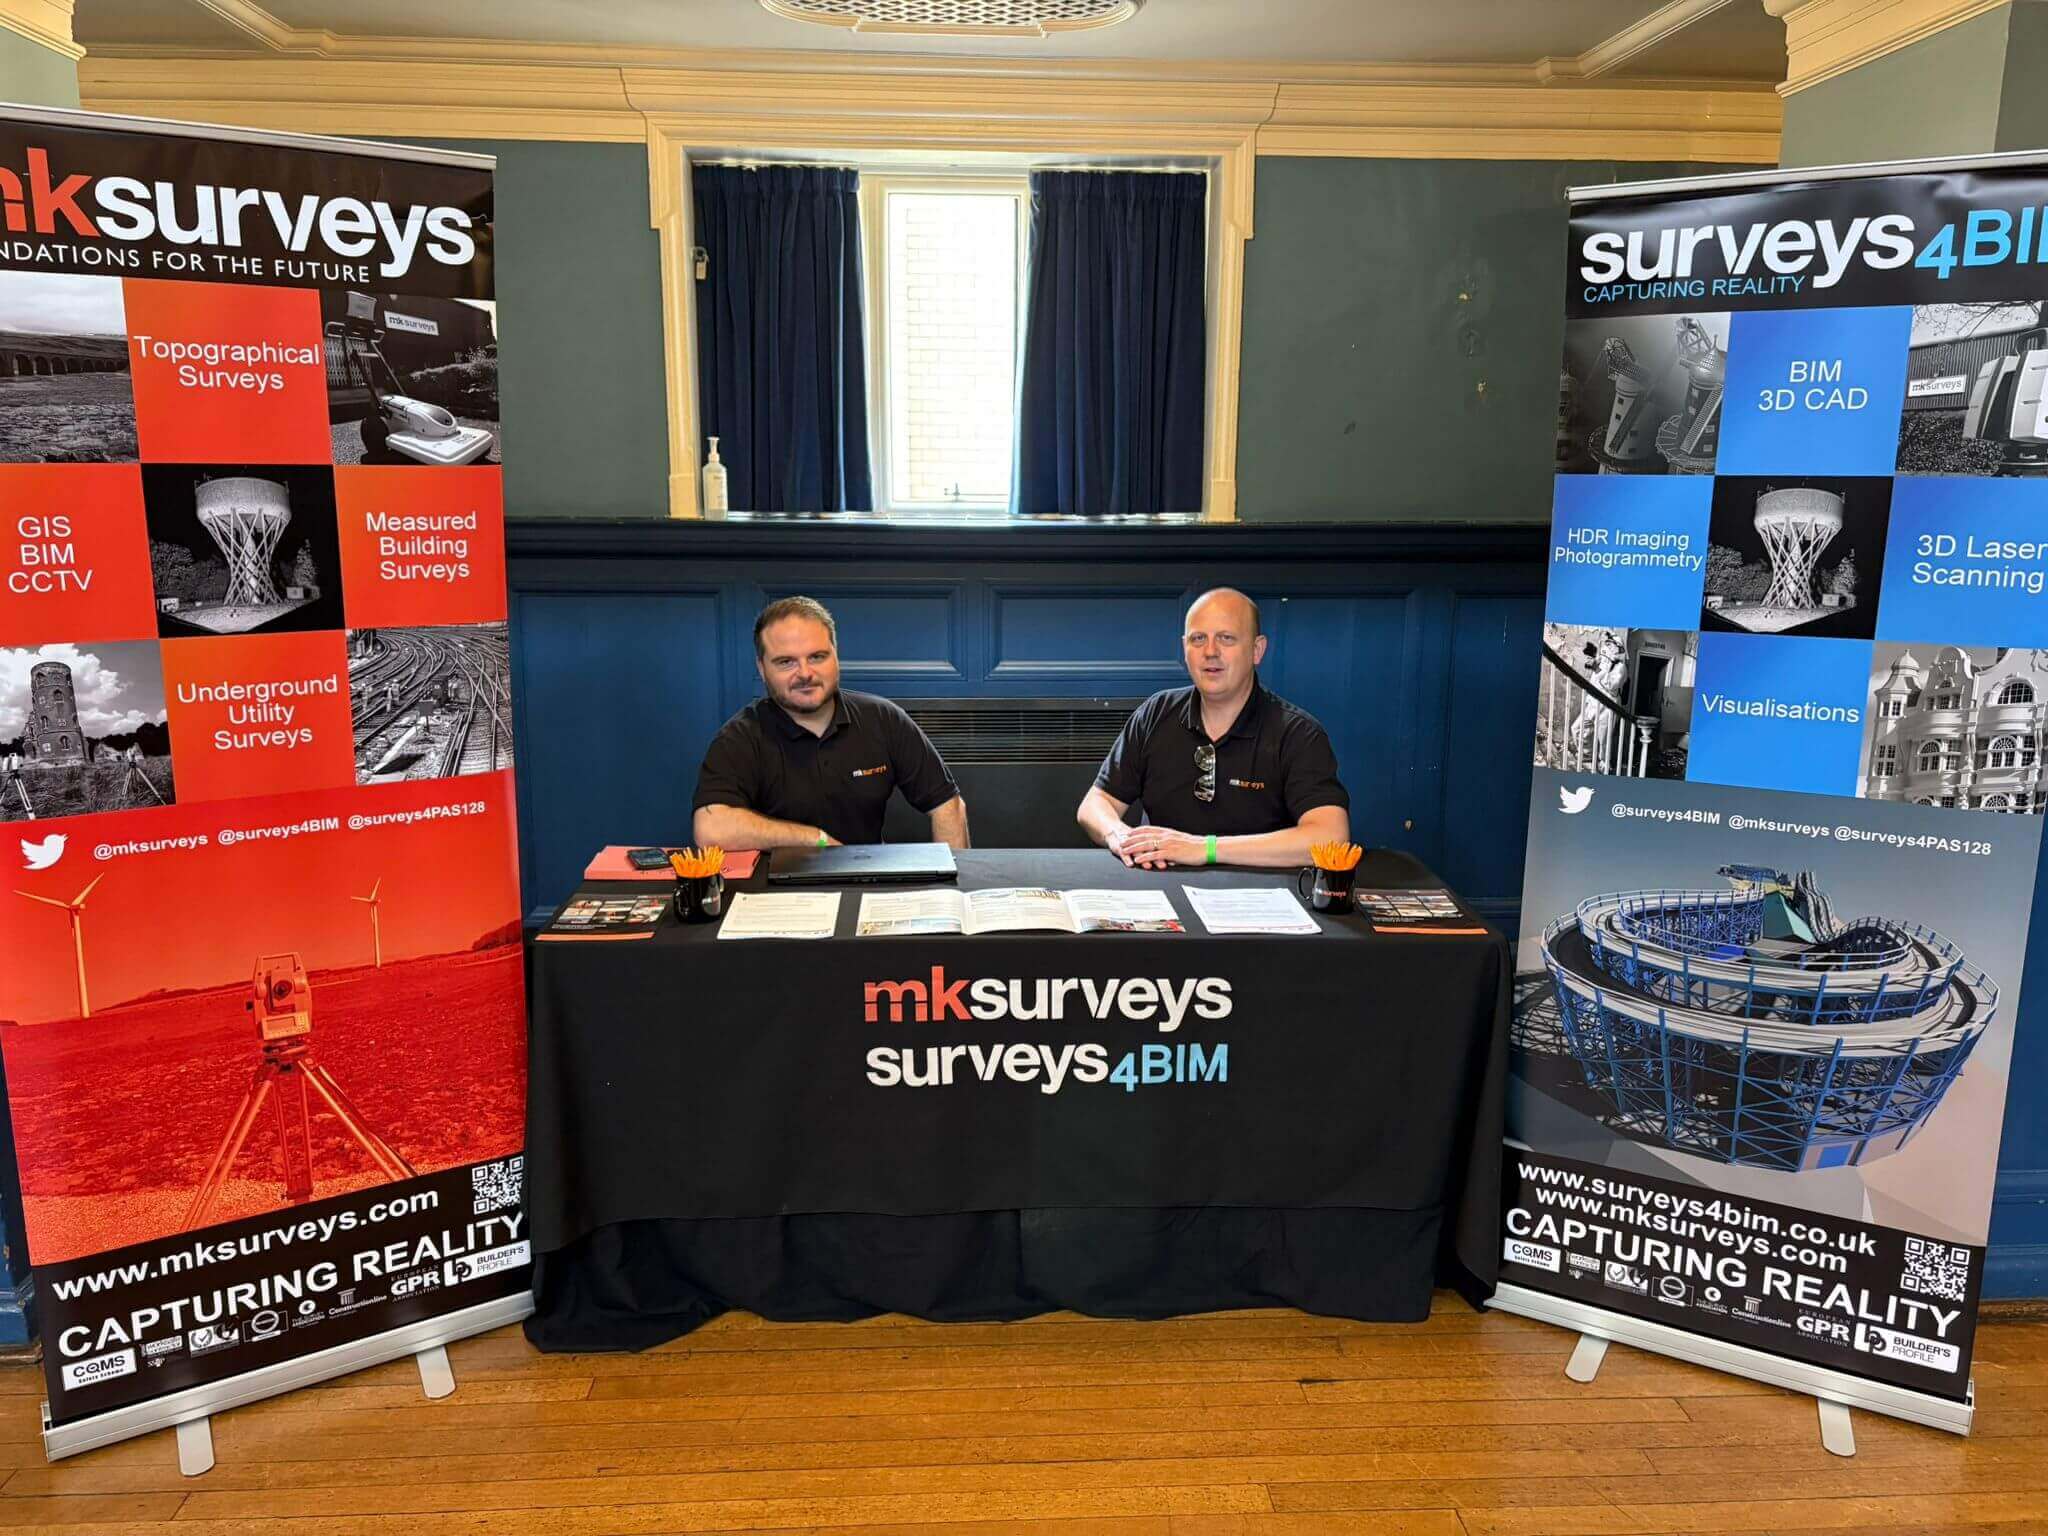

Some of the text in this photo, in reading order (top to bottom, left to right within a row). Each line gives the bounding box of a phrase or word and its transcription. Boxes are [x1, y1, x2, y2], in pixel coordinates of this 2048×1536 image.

[0, 147, 476, 278] ksurveys
[1580, 206, 2048, 289] surveys4BI
[152, 251, 205, 272] FOR
[212, 254, 264, 275] THE
[275, 260, 370, 283] FUTURE
[1584, 275, 1805, 303] CAPTURING REALITY
[133, 336, 320, 367] Topographical
[179, 365, 285, 394] Surveys
[1790, 359, 1842, 383] BIM
[1758, 387, 1869, 411] 3D CAD
[17, 515, 72, 538] GIS
[365, 510, 477, 532] Measured
[379, 535, 468, 559] Building
[1567, 527, 1690, 551] HDR Imaging
[1916, 534, 2048, 560] 3D Laser
[20, 543, 75, 566] BIM
[1554, 546, 1704, 572] Photogrammetry
[8, 569, 93, 593] CCTV
[380, 560, 471, 583] Surveys
[1912, 561, 2045, 594] Scanning
[177, 673, 339, 704] Underground
[228, 703, 295, 725] Utility
[1701, 693, 1860, 723] Visualisations
[214, 727, 313, 750] Surveys
[94, 800, 486, 860] @mksurveys @surveys4BIM @surveys4PAS128
[1611, 803, 1992, 855] @surveys4BIM @mksurveys @surveys4PAS128
[863, 966, 1233, 1032] mksurveys
[865, 1043, 1229, 1095] surveys4BIM
[1517, 1162, 1876, 1257] www.surveys4bim.co.uk
[1535, 1187, 1848, 1274] www.mksurveys.com
[52, 1187, 439, 1302] www.mksurveys.com
[476, 1246, 525, 1264] BUILDER'S
[1512, 1244, 1553, 1261] CQMS
[477, 1259, 513, 1273] PROFILE
[1505, 1207, 1961, 1338] CAPTURING REALITY
[58, 1211, 524, 1357] CAPTURING REALITY
[390, 1271, 441, 1295] GPR
[1796, 1316, 1850, 1342] GPR
[1892, 1346, 1935, 1364] PROFILE
[1893, 1336, 1951, 1358] BUILDER'S
[73, 1355, 126, 1378] CQMS
